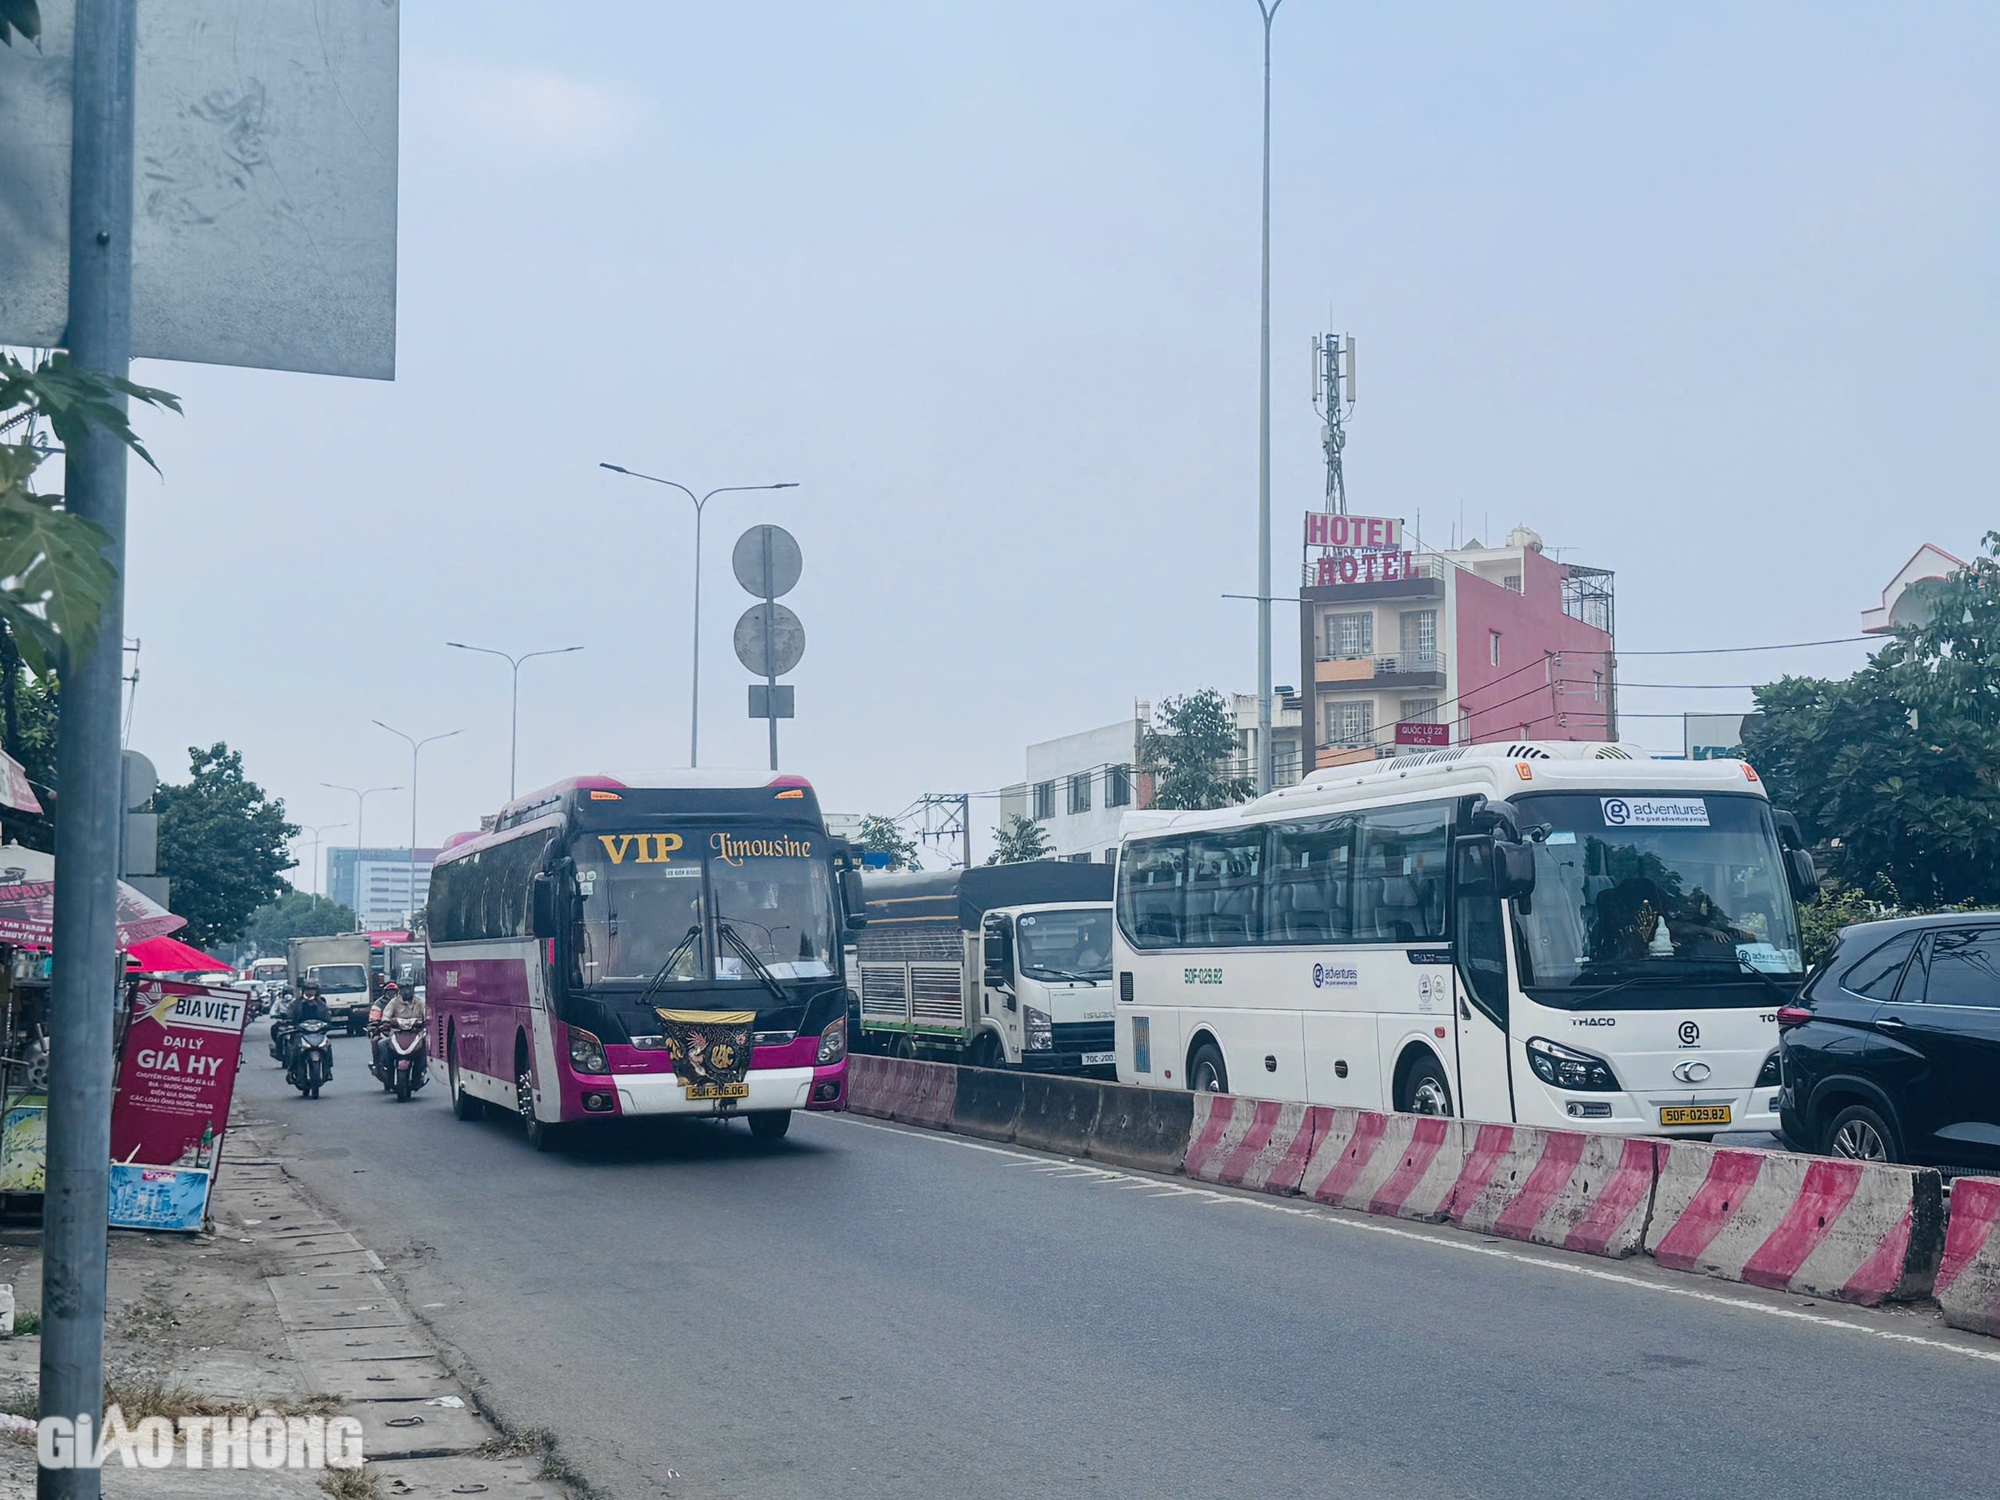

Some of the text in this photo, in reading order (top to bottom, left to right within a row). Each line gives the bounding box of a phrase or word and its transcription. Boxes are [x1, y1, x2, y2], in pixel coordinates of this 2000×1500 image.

[1309, 514, 1399, 551] HOTEL
[1317, 551, 1420, 586] HOTEL
[1434, 727, 1443, 735] 22
[1427, 736, 1432, 744] 2
[1633, 802, 1706, 816] adventures
[598, 833, 683, 864] VIP
[710, 832, 811, 867] Limousine
[1325, 966, 1357, 979] adventures
[175, 999, 240, 1023] BIA VIỆT
[1570, 1017, 1616, 1026] THACO
[163, 1036, 204, 1050] ĐẠI LÝ
[137, 1049, 223, 1076] GIA HY
[1666, 1108, 1725, 1121] 50F-029.82
